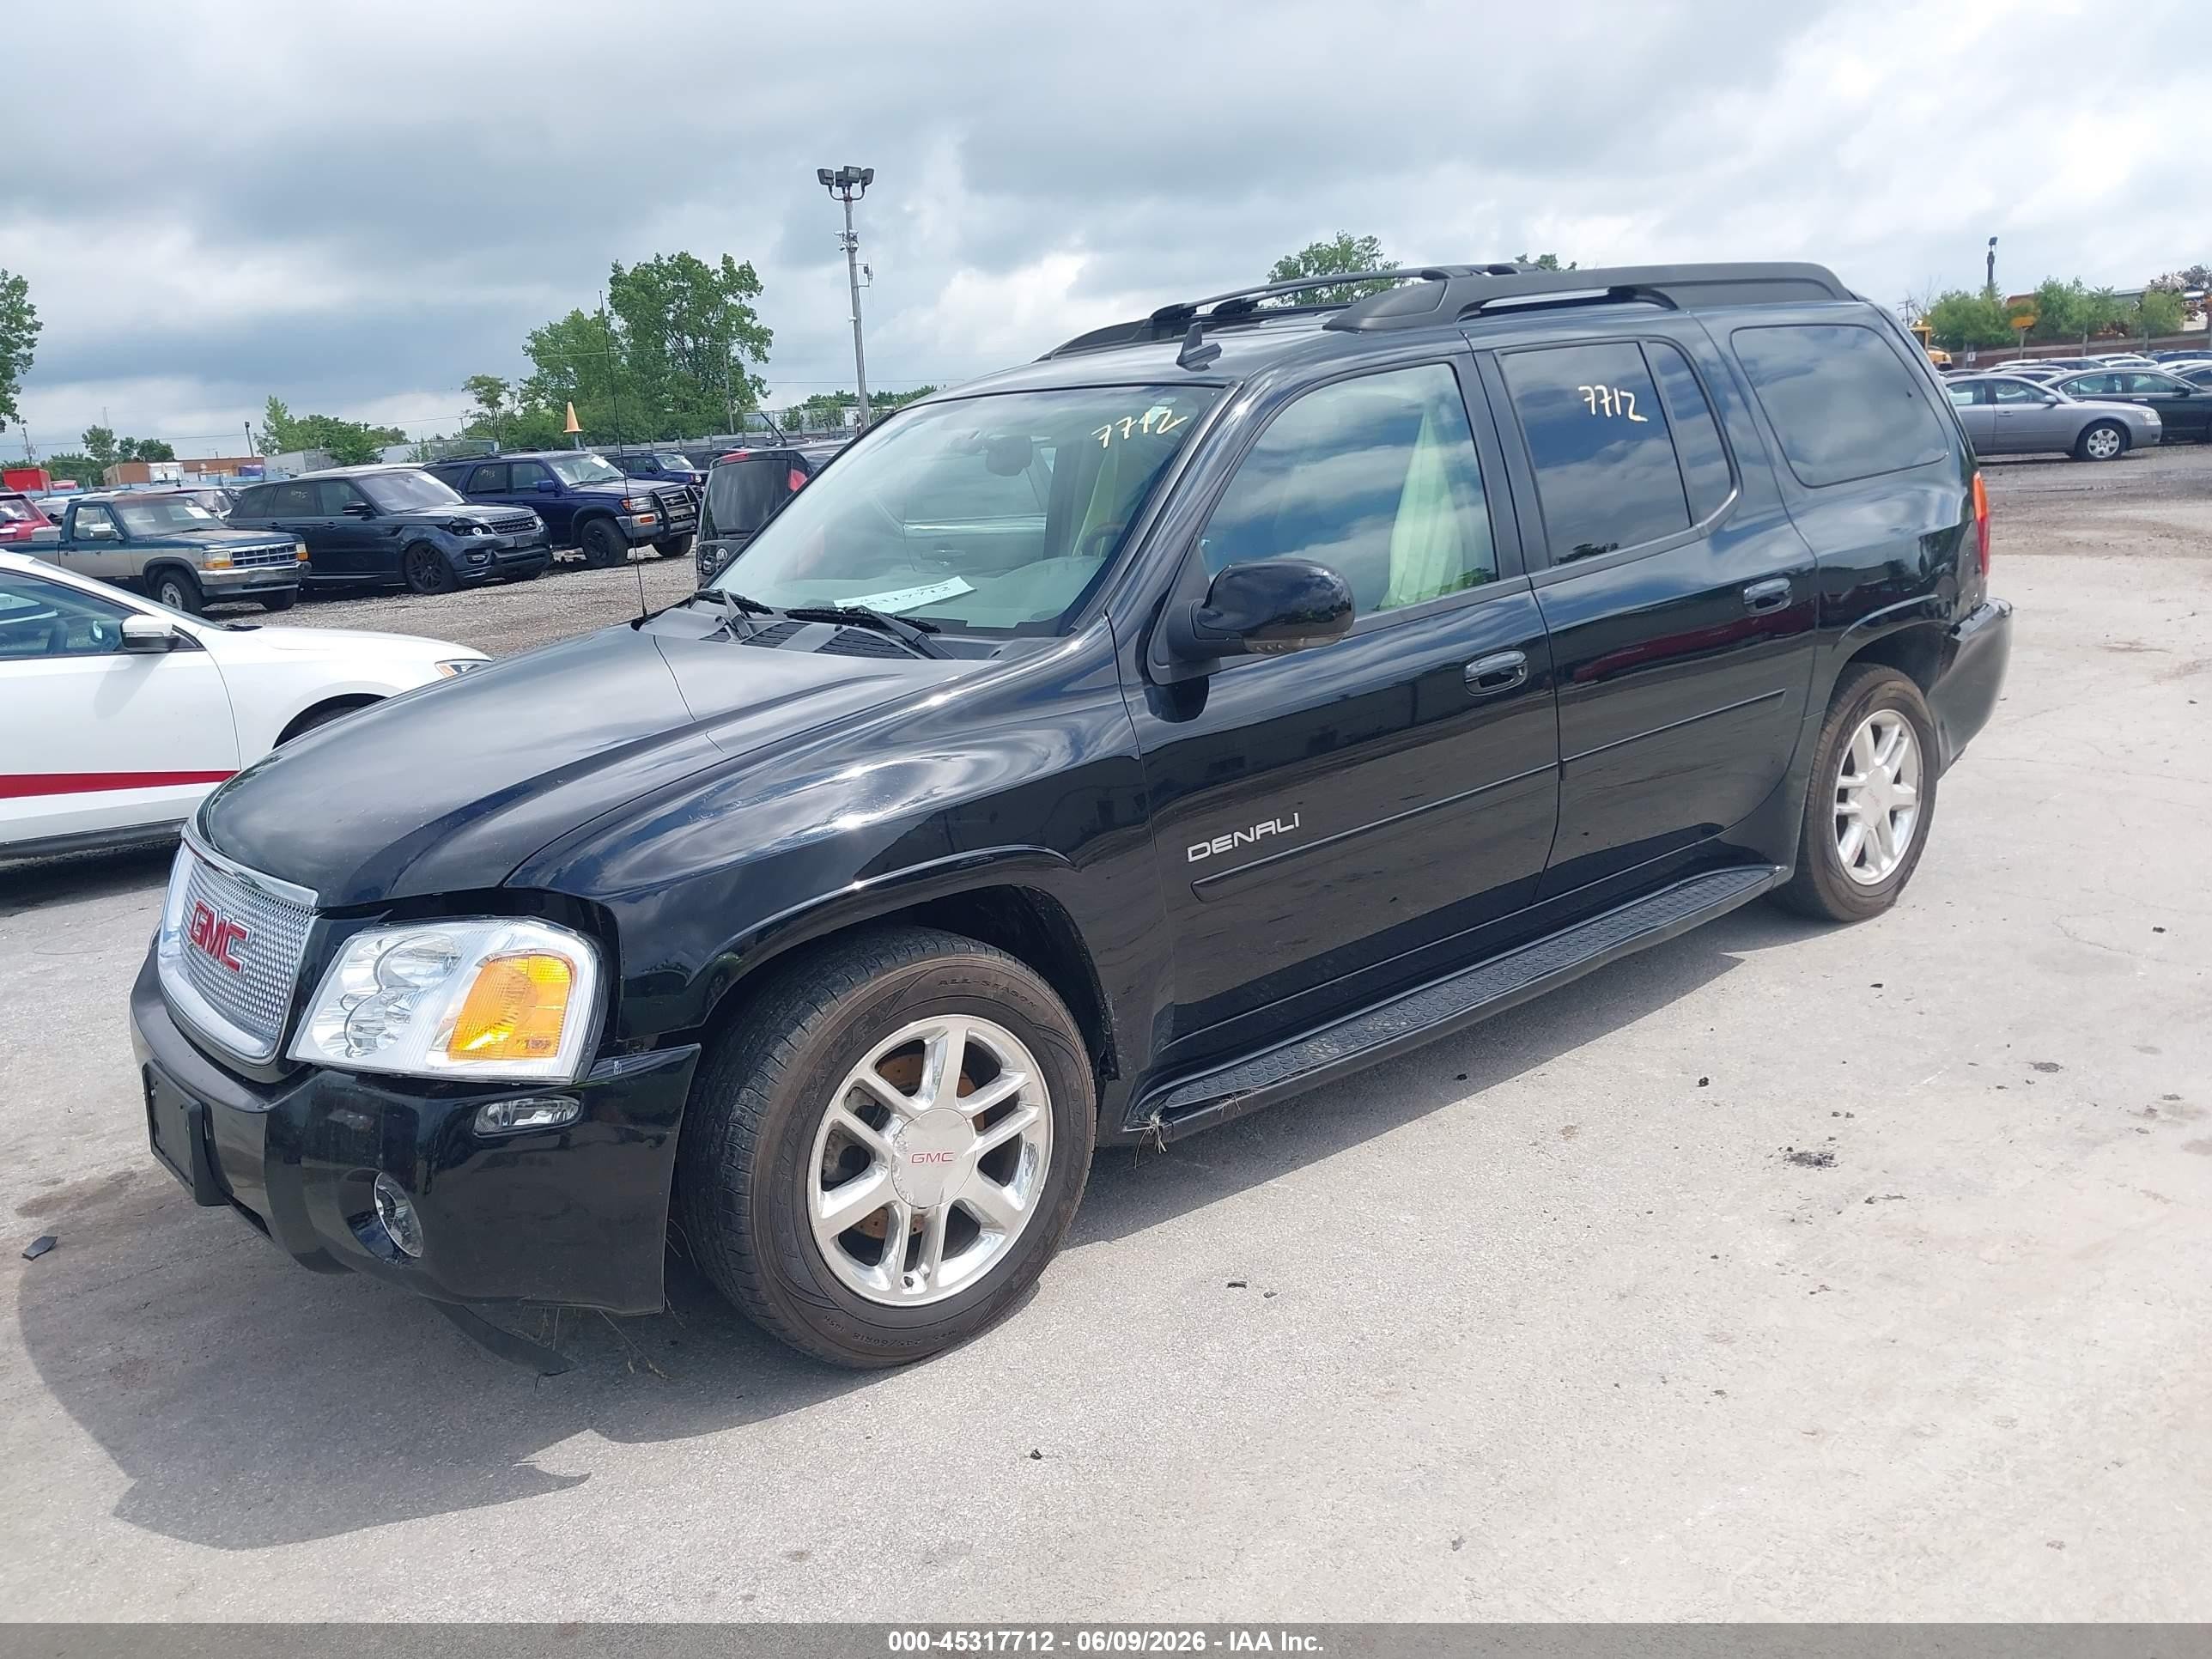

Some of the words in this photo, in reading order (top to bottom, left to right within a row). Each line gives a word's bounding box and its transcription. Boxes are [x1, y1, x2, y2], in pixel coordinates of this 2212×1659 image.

[1578, 385, 1649, 422] 7712
[1091, 409, 1188, 448] 7712
[1187, 812, 1299, 863] DENALI
[190, 898, 252, 973] GMC
[937, 978, 1038, 1009] ALL-SEASON
[911, 1152, 955, 1164] GMC
